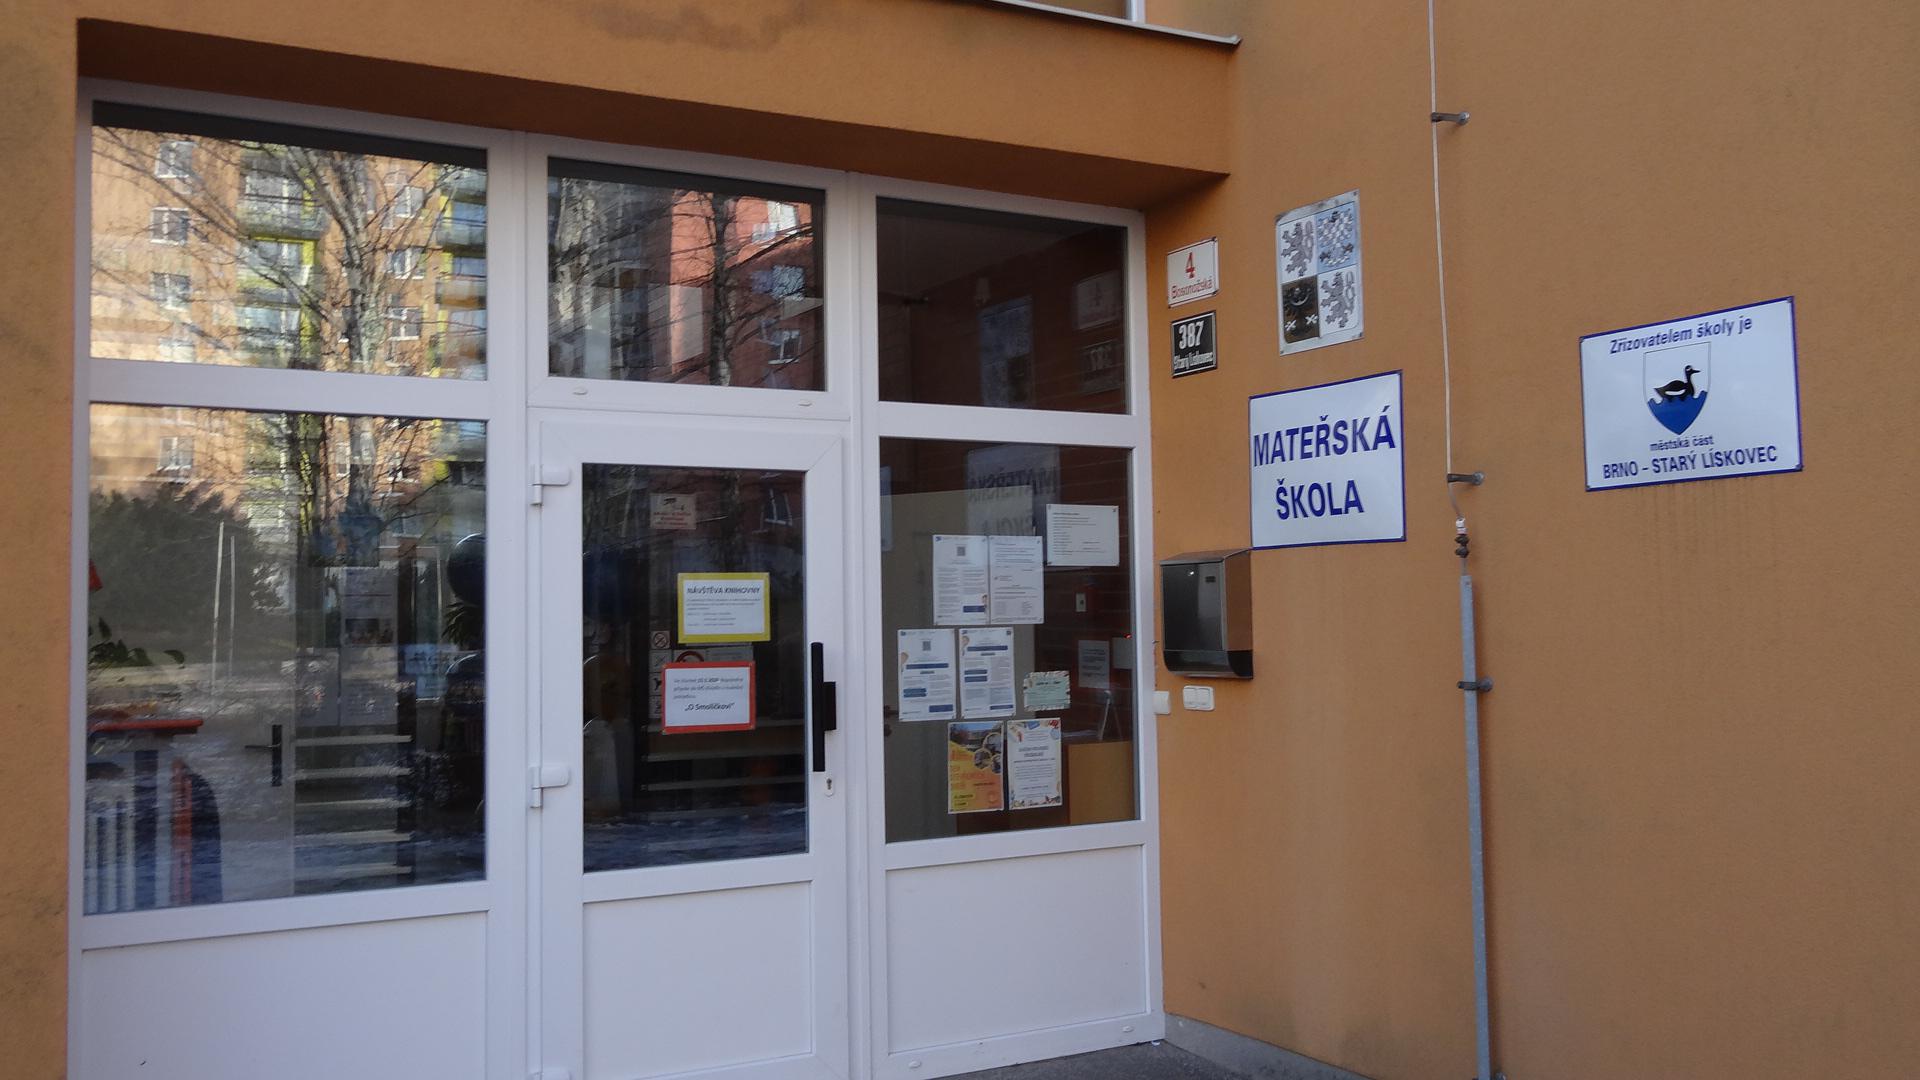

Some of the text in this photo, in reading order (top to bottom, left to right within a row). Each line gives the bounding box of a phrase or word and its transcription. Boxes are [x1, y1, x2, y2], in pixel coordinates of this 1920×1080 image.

[1185, 251, 1195, 279] 4
[1178, 320, 1204, 350] 387
[1696, 317, 1735, 338] školy
[1738, 315, 1753, 335] je
[1253, 405, 1396, 467] MATEŘSKÁ
[1649, 434, 1715, 452] městská část
[1602, 460, 1638, 479] BRNO
[1652, 450, 1698, 474] STARÝ
[1702, 445, 1779, 469] LÍSKOVEC
[1275, 477, 1365, 521] ŠKOLA
